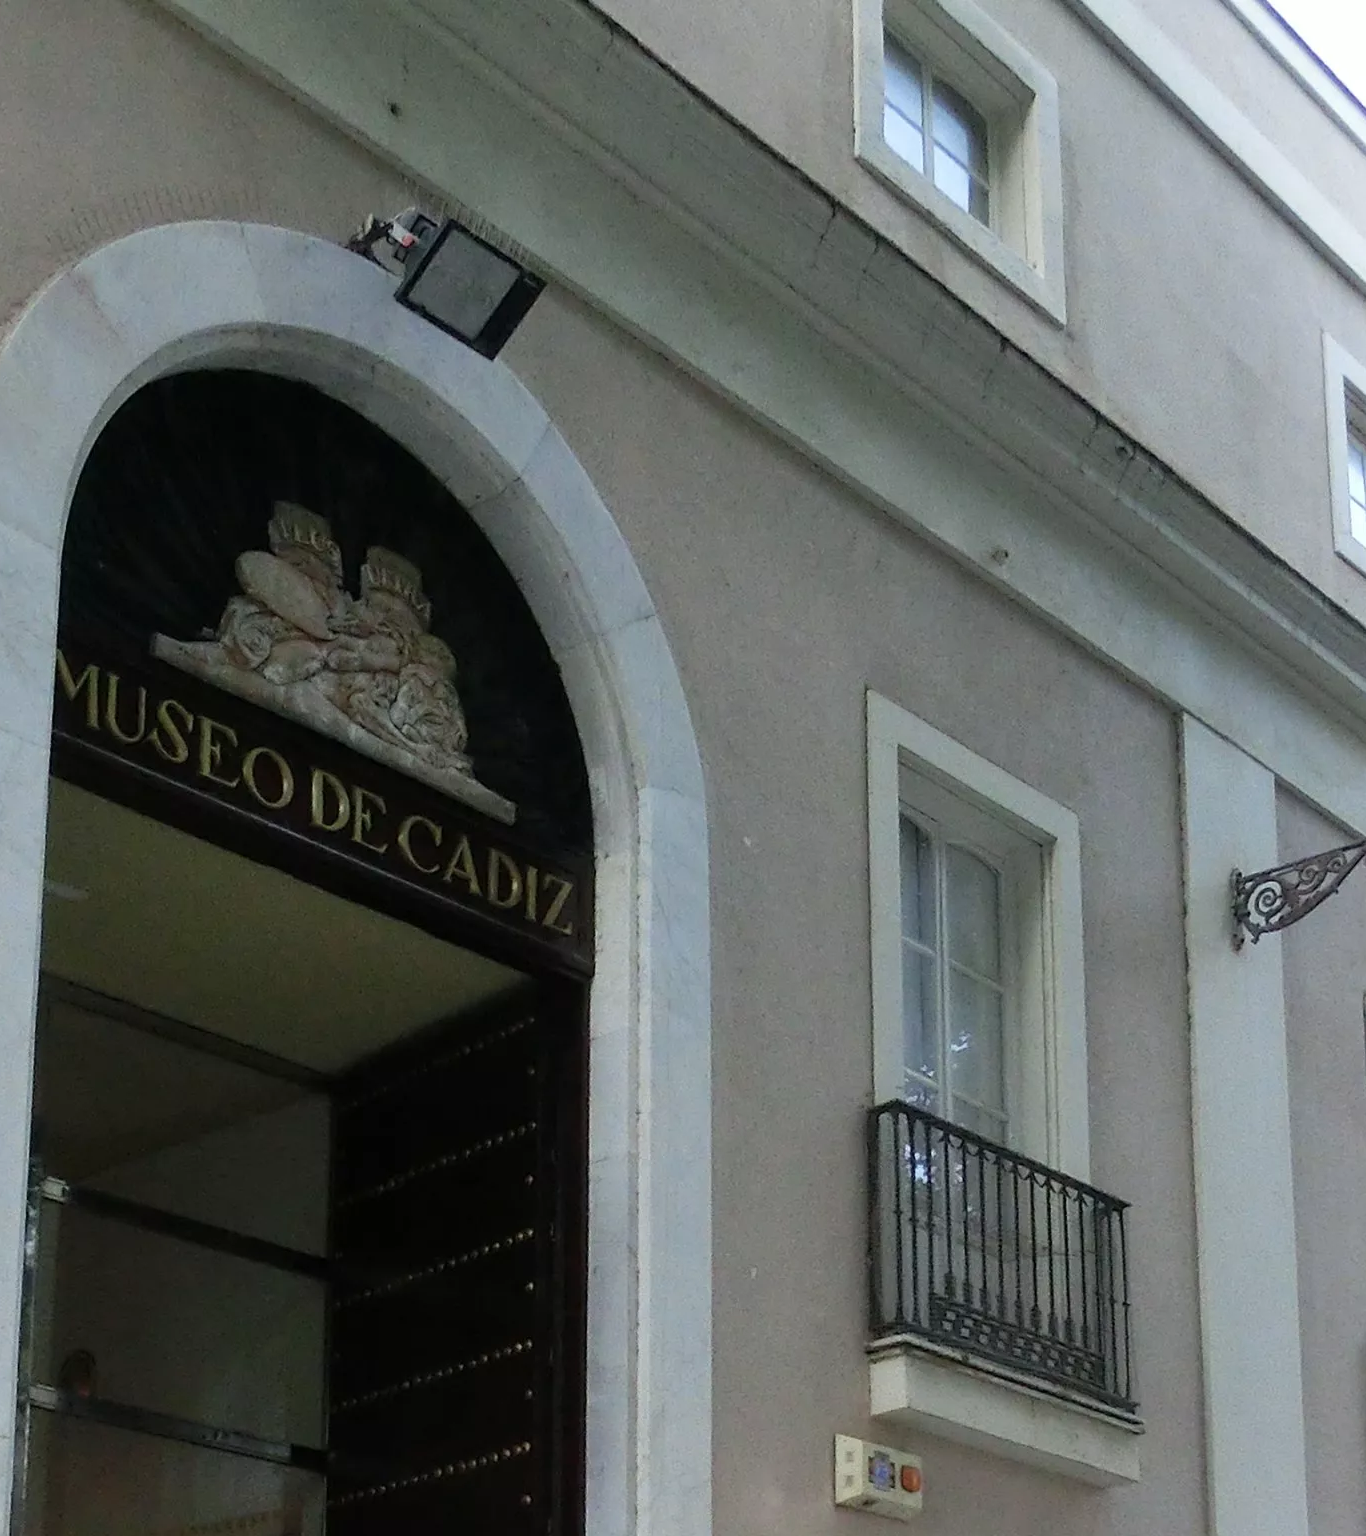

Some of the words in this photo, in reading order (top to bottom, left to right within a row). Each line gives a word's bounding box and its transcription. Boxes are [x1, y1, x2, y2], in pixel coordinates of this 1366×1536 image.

[56, 648, 295, 810] MUSEO
[310, 766, 389, 854] DE
[396, 814, 576, 936] CADIZ
